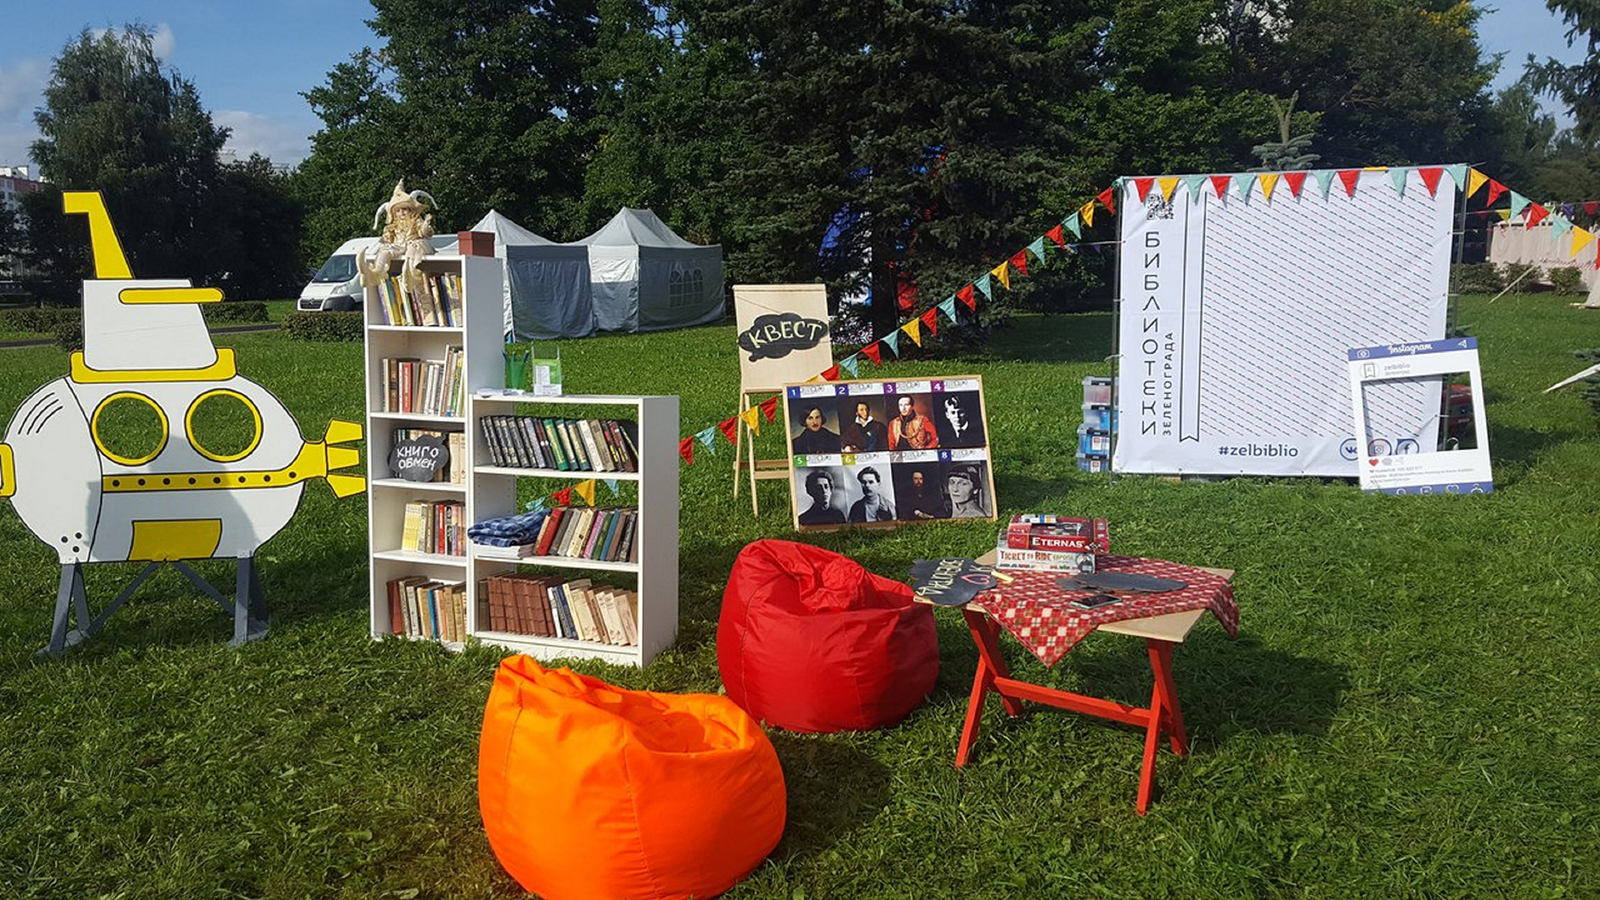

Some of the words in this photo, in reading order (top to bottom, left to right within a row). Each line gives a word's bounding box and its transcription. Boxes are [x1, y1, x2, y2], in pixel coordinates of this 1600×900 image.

[748, 320, 823, 349] КВЕСТ
[1141, 231, 1161, 436] БИБЛИОТЕКИ
[1388, 343, 1433, 356] Instagram
[1162, 332, 1175, 436] ЗЕЛЕНОГРАДА
[396, 445, 440, 459] КНИГО
[1218, 443, 1299, 457] #zelbiblio
[397, 457, 438, 471] ОБМЕН
[1032, 537, 1083, 548] ETERNAS
